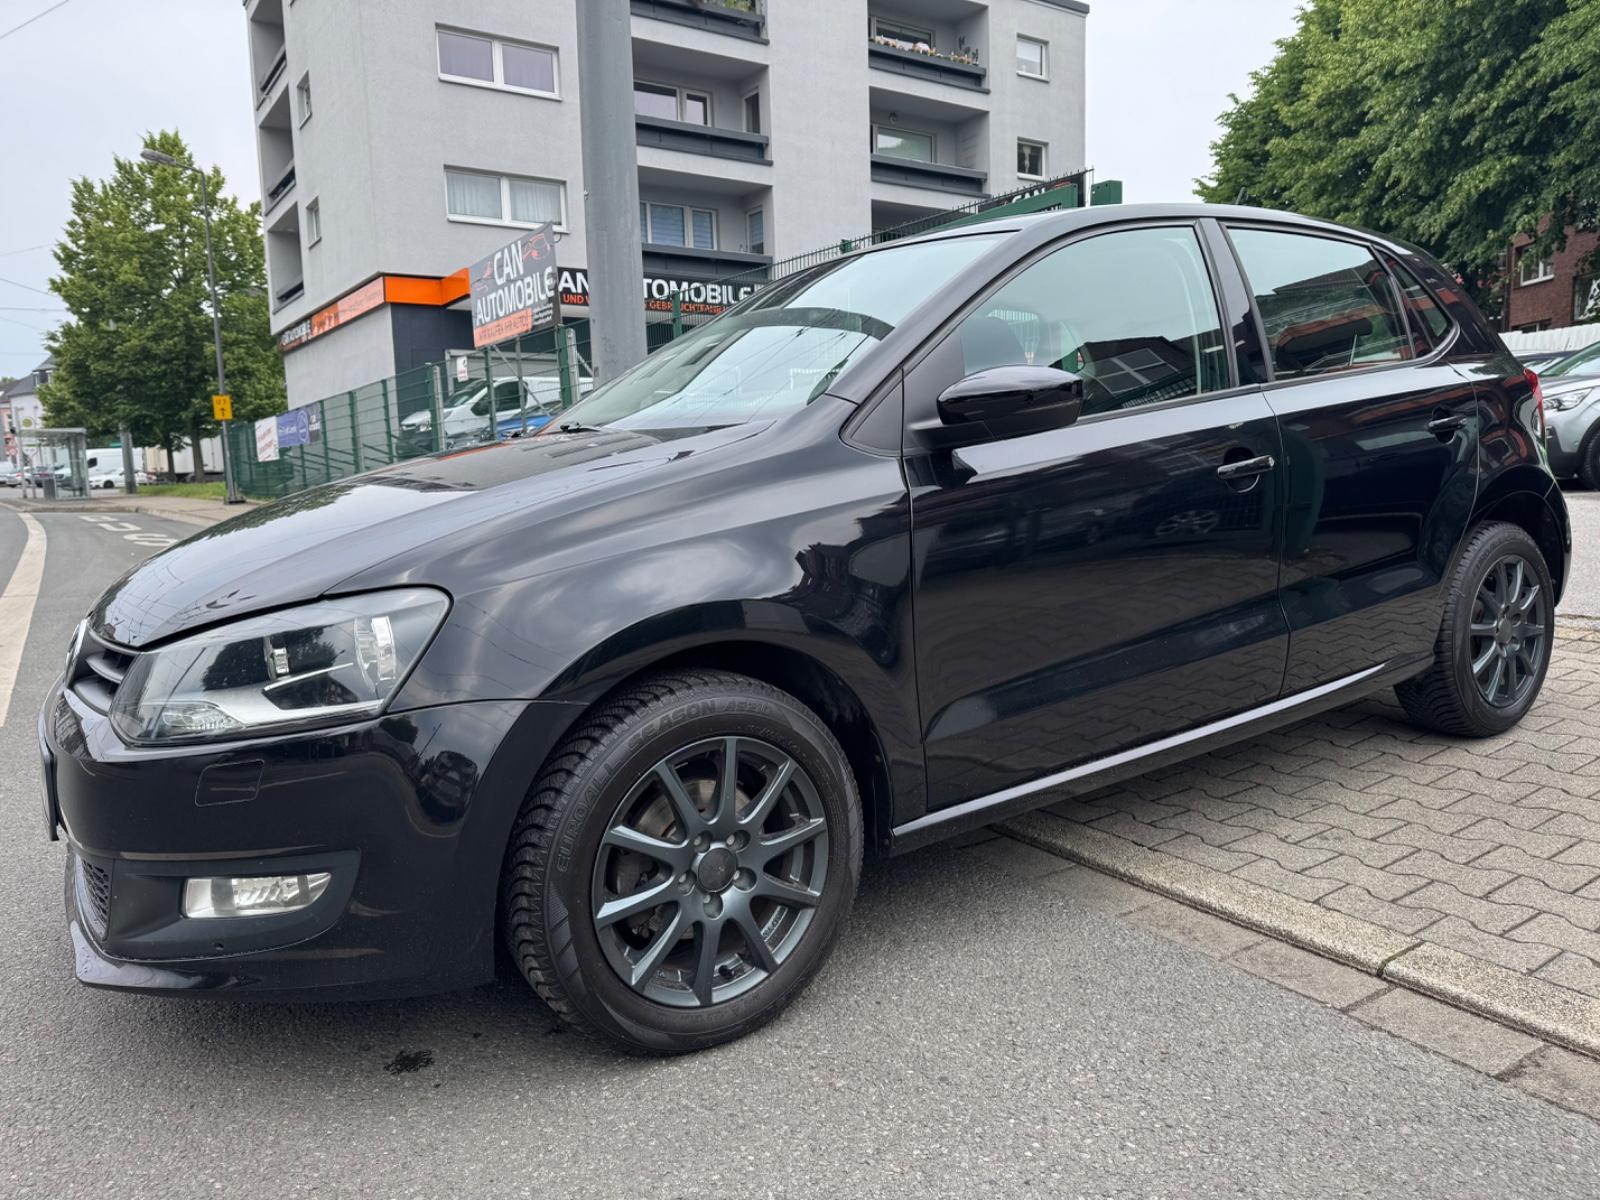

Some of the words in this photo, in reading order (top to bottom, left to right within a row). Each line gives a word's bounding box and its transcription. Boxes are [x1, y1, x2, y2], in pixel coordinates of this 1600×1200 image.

[494, 240, 525, 286] CAN
[476, 265, 555, 327] AUTOMOBILE
[558, 270, 589, 293] AN
[643, 278, 752, 305] TOMOBILE
[563, 294, 584, 304] UND
[628, 700, 716, 752] SEASON
